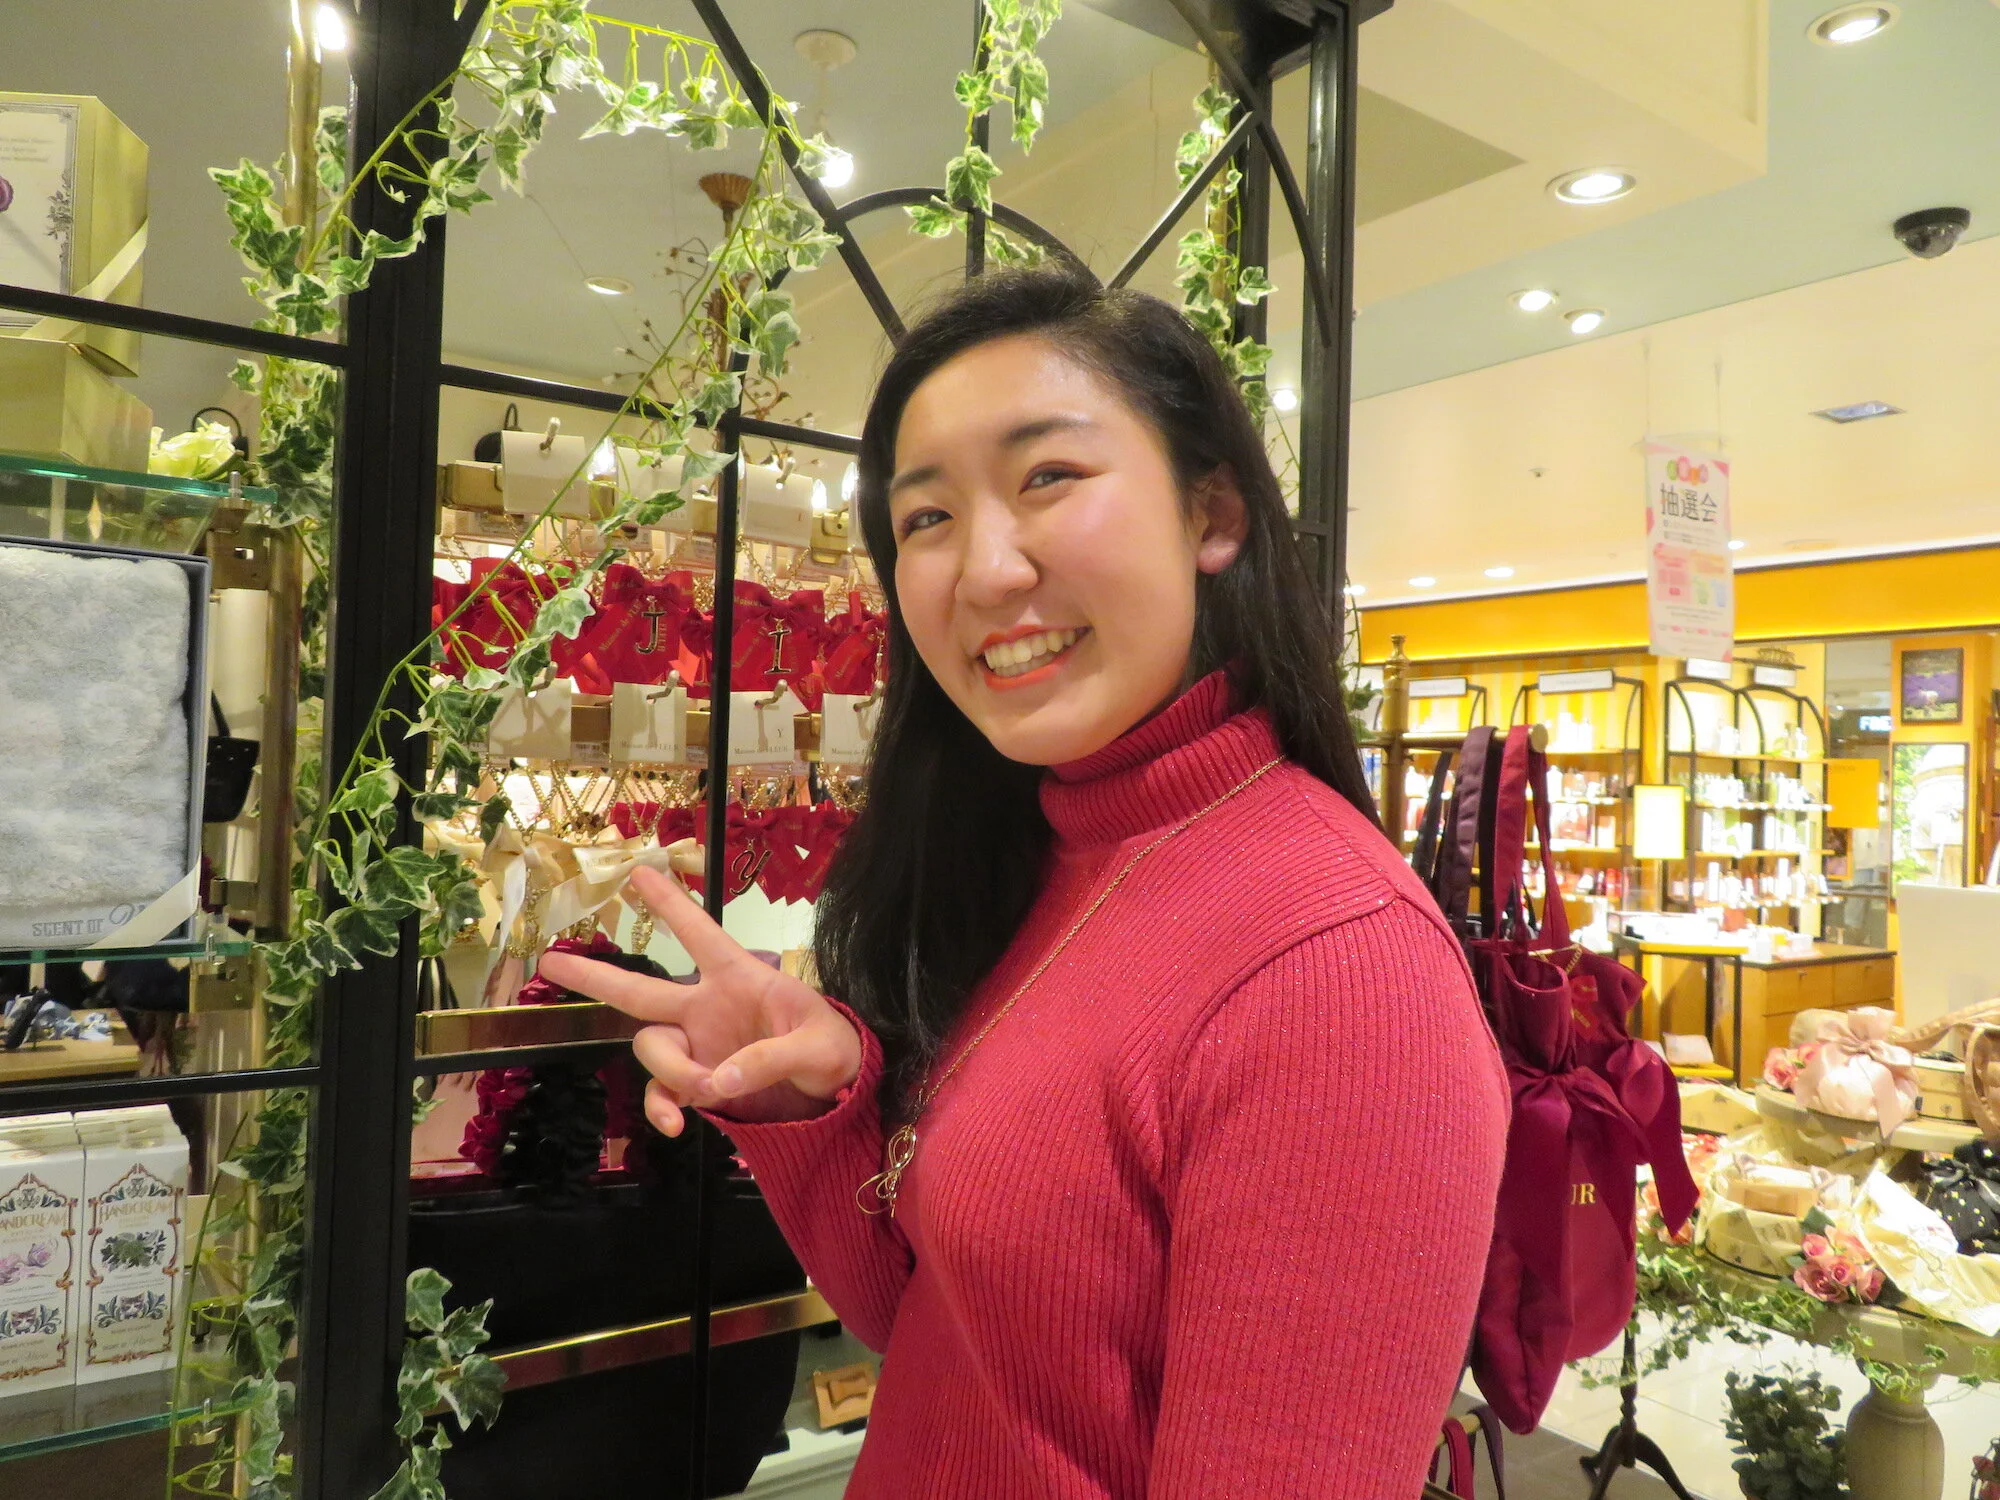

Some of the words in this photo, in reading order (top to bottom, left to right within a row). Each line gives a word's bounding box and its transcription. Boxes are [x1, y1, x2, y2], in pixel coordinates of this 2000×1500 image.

[1660, 482, 1718, 522] 抽選会
[634, 609, 667, 655] J
[764, 627, 792, 675] I
[32, 919, 83, 937] SCENT
[87, 918, 105, 934] OF
